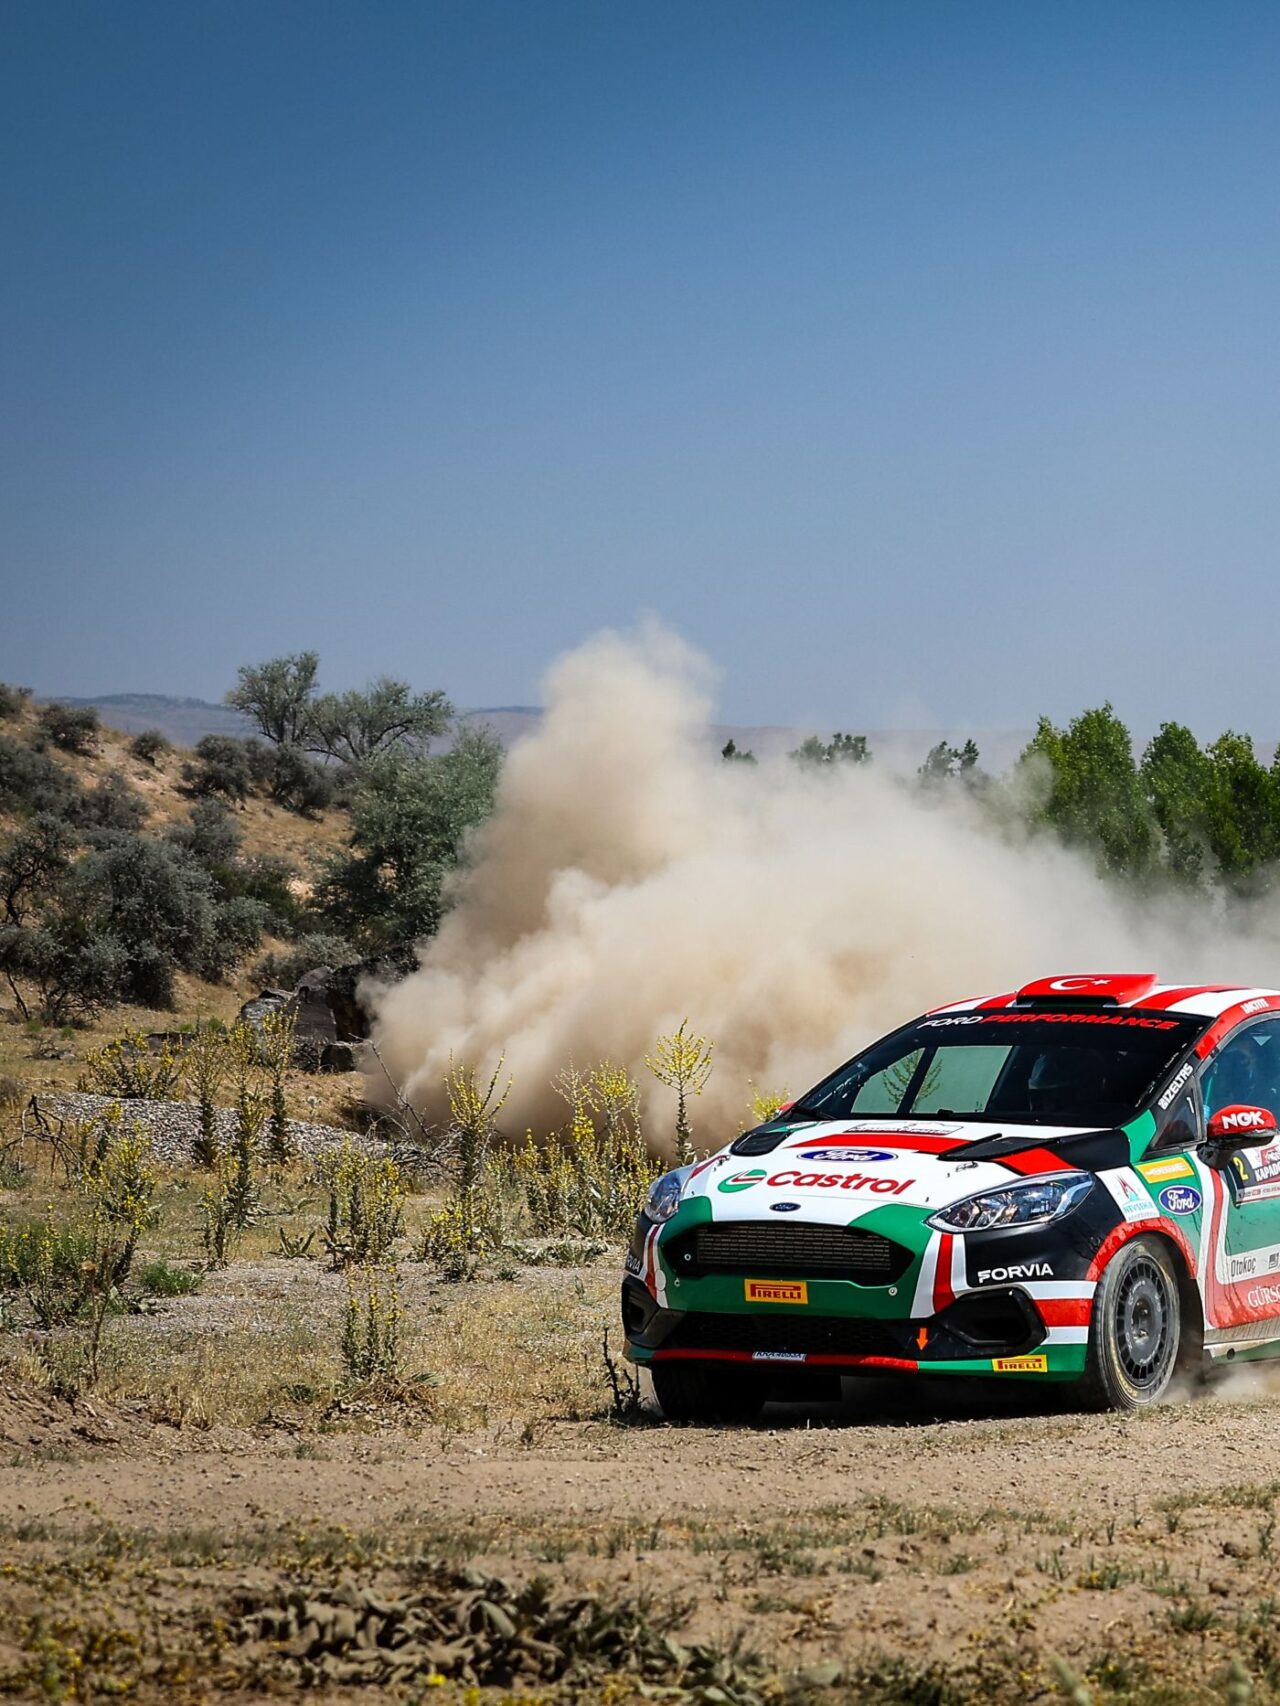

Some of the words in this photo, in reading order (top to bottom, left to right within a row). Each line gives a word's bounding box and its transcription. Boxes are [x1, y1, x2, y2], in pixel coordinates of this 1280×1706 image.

[916, 1015, 984, 1029] FORD
[979, 1013, 1181, 1030] PERFORMANCE
[1221, 1110, 1265, 1129] NGK
[1232, 1156, 1249, 1181] 2
[767, 1170, 916, 1195] Castrol
[1166, 1189, 1195, 1211] Ford
[977, 1262, 1054, 1284] FORVIA
[750, 1283, 801, 1299] PIRELLI
[997, 1358, 1042, 1370] PIRELLI
